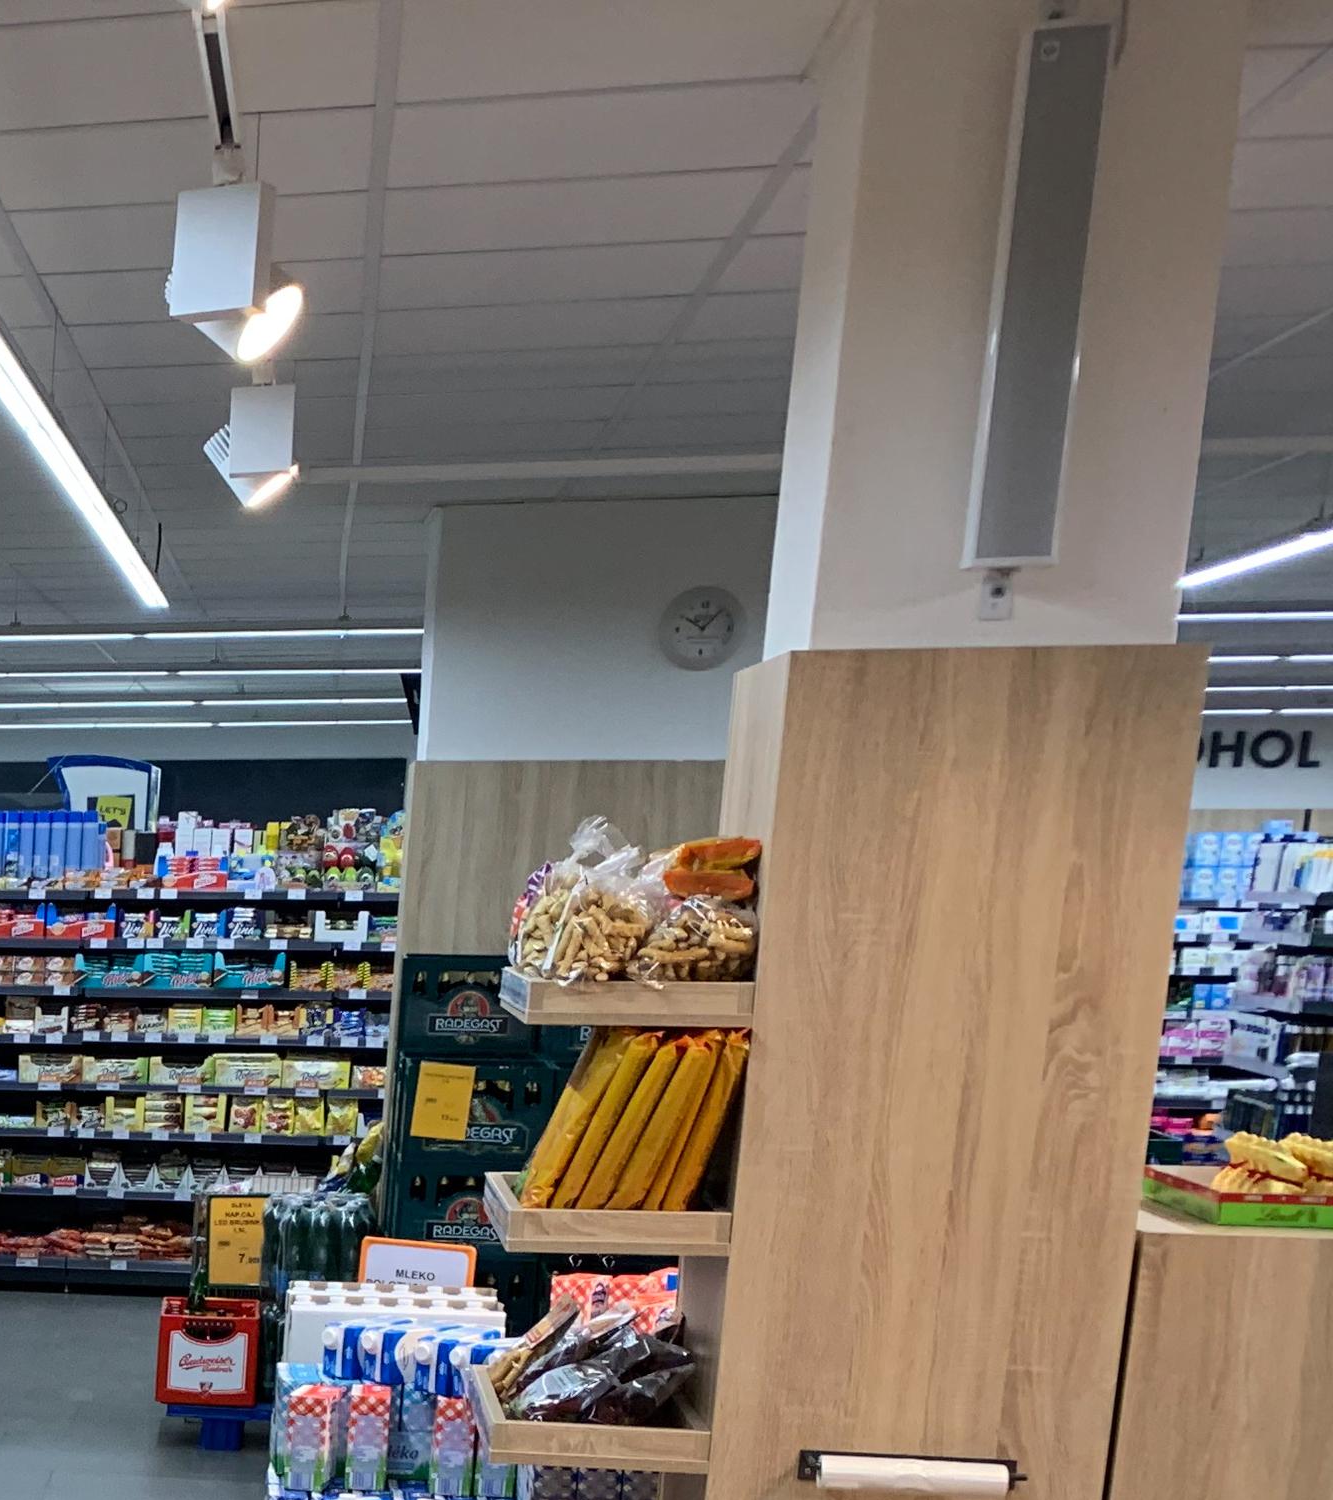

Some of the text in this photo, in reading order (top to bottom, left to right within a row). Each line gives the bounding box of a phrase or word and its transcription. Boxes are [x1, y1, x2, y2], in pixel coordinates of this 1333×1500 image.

[1197, 729, 1320, 768] HOL
[435, 1018, 503, 1033] RADEGAST
[465, 1127, 517, 1144] DEGAST
[433, 1225, 497, 1240] RADEGAS
[395, 1268, 435, 1282] MLEKO
